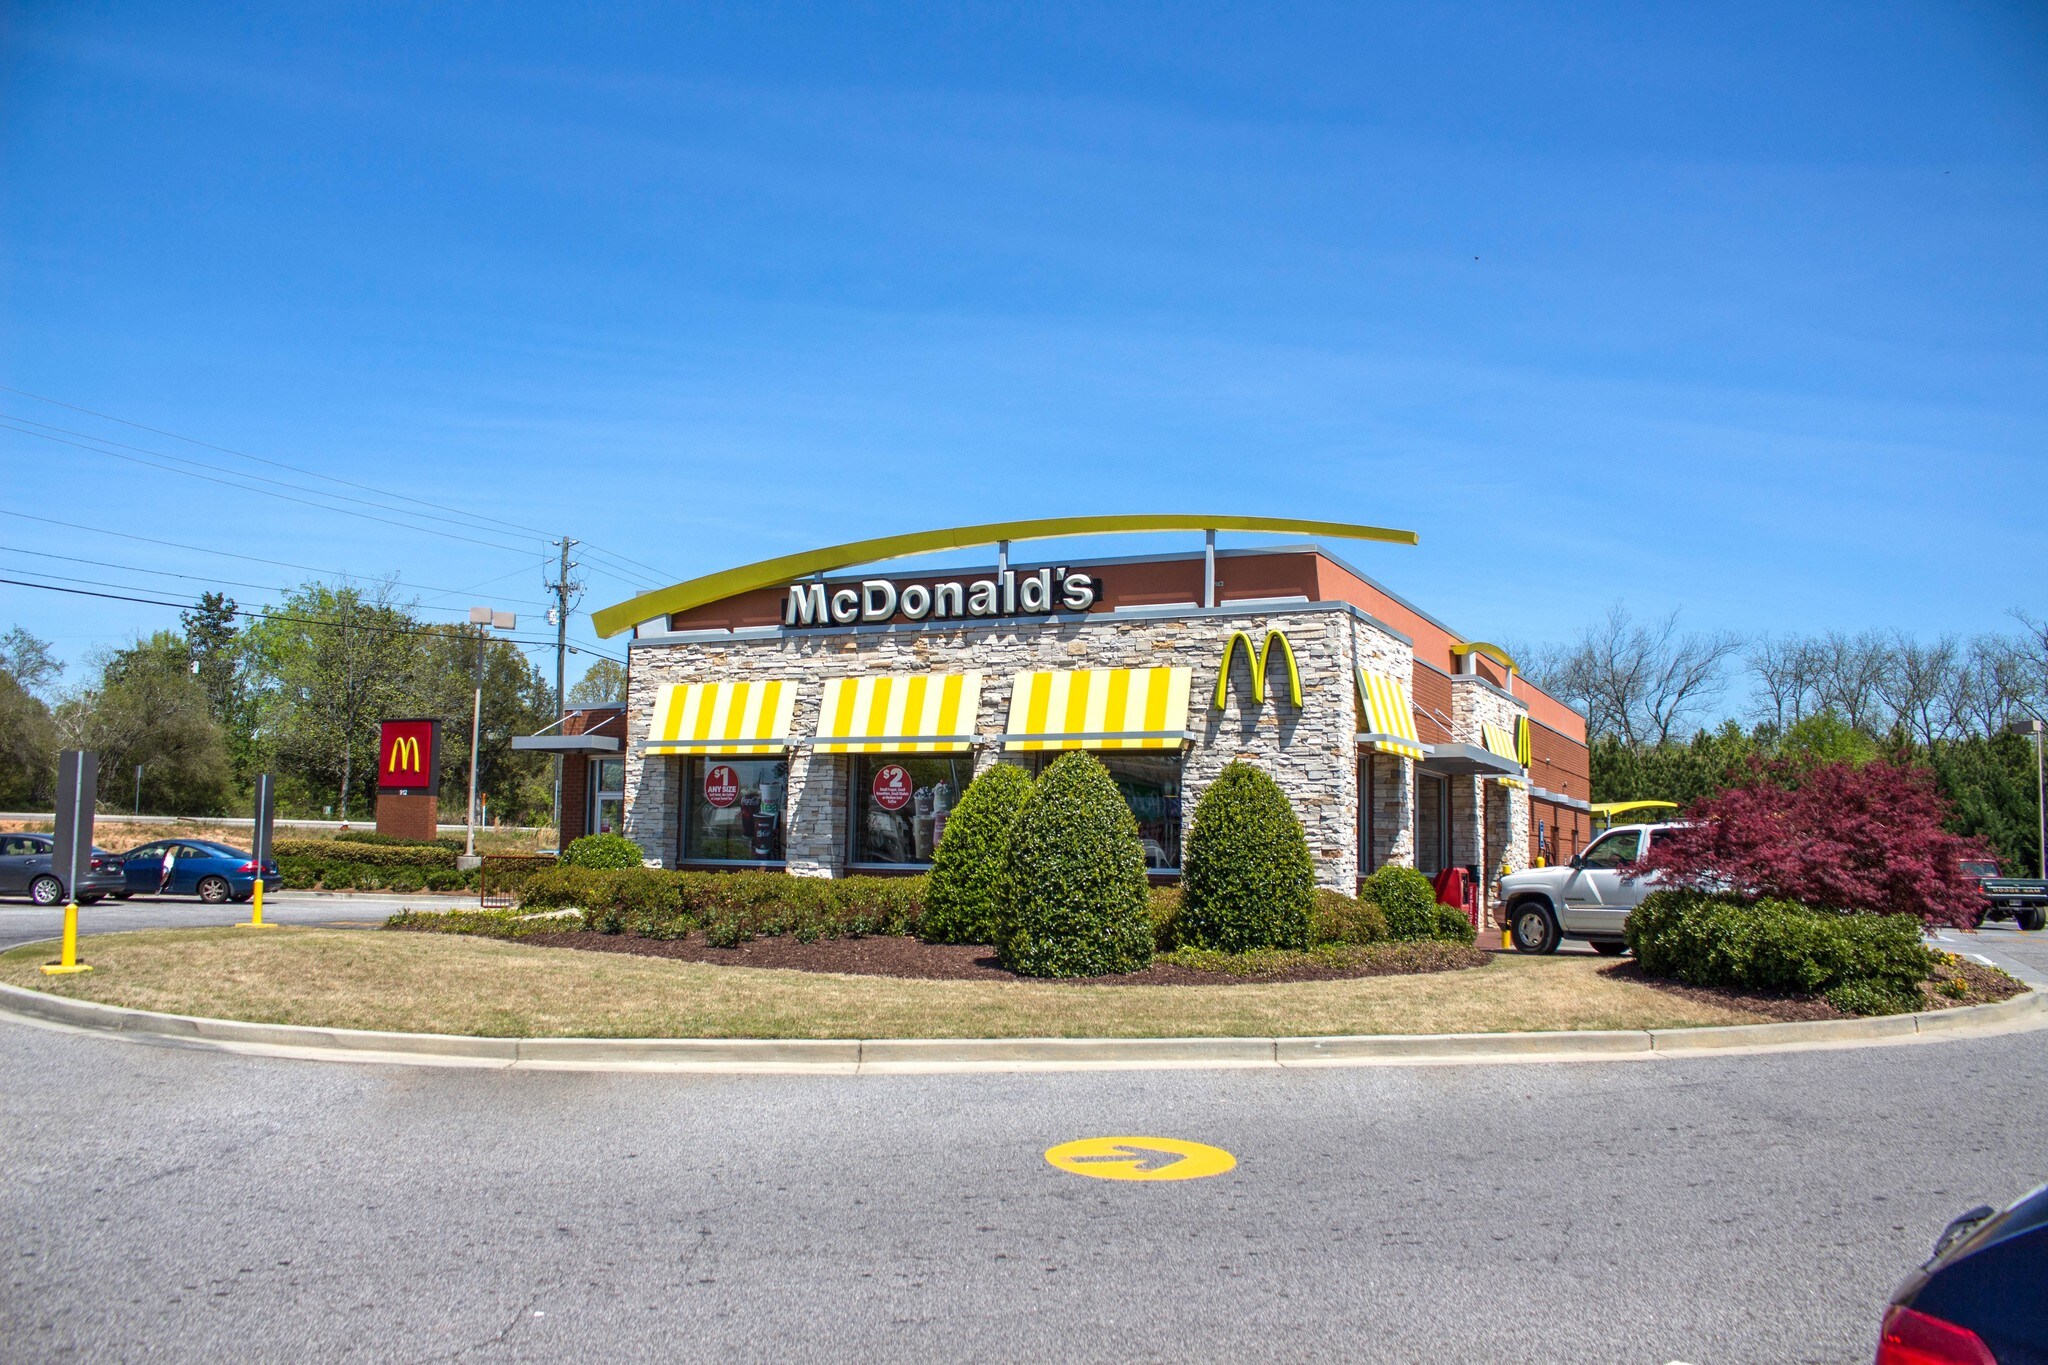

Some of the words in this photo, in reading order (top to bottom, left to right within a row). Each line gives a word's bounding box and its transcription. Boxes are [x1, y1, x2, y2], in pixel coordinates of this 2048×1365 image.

[785, 566, 1095, 625] McDonald's
[714, 767, 729, 786] $1
[883, 767, 903, 788] $2
[708, 785, 721, 793] ANY
[722, 785, 737, 793] SIZE
[761, 802, 778, 813] tea
